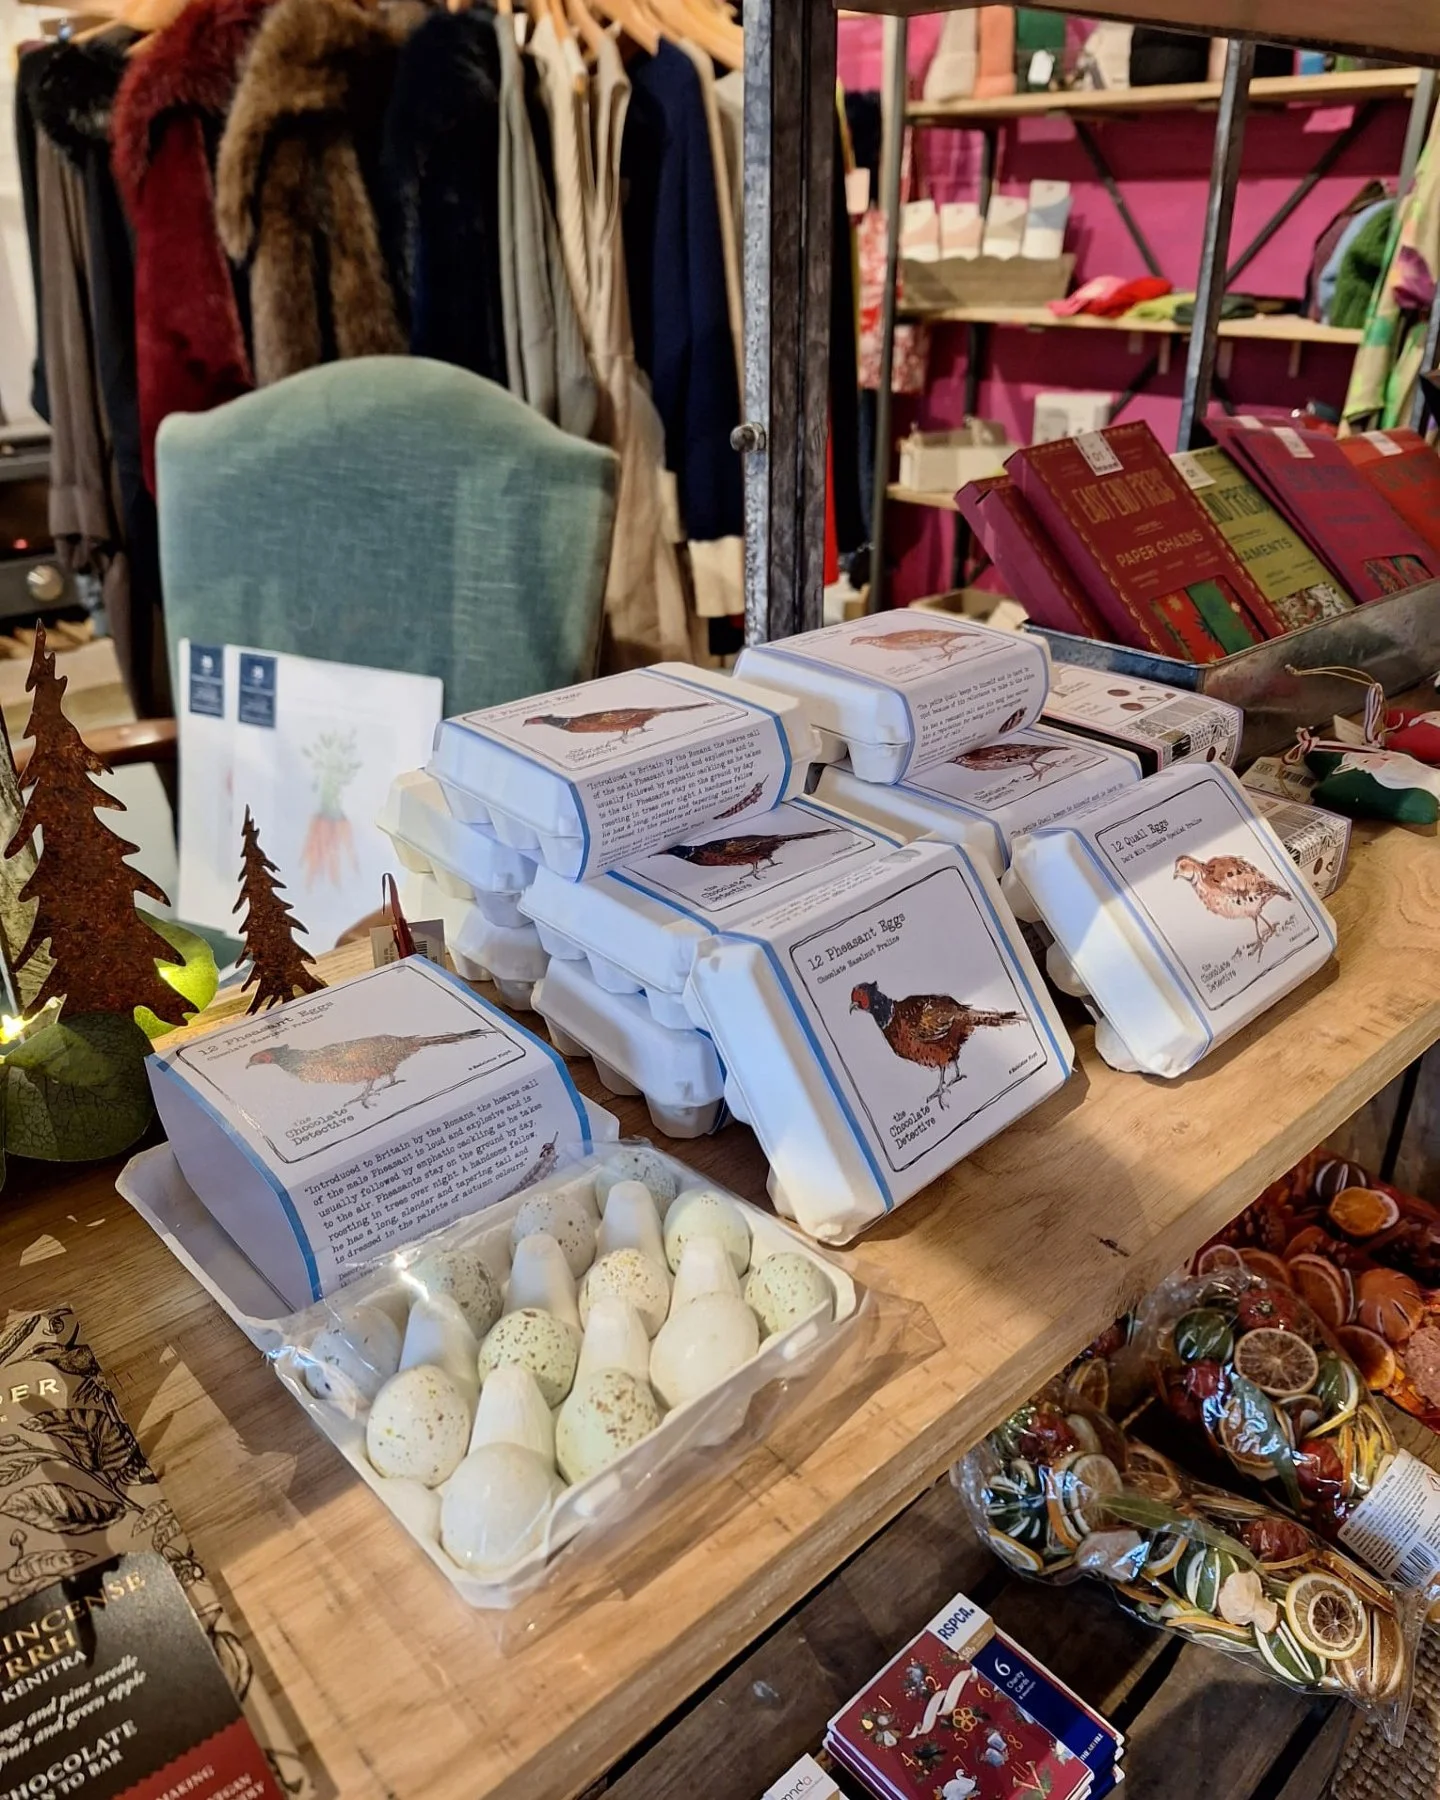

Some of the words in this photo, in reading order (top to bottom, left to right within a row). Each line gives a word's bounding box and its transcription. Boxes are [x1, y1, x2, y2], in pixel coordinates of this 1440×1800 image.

[1116, 545, 1158, 567] PAPER
[1156, 528, 1203, 553] CHAINS
[1111, 840, 1124, 852] 12
[1124, 828, 1148, 848] Quail
[1147, 819, 1169, 834] Eggs
[808, 955, 824, 971] 12
[825, 927, 877, 962] Pheasant
[878, 913, 906, 932] Eggs
[817, 965, 846, 984] Chocolate
[847, 948, 876, 968] Hazelnut
[876, 936, 900, 952] Praline
[198, 1045, 218, 1055] 12
[223, 1017, 294, 1046] Pheasant
[298, 1002, 334, 1017] Eggs
[285, 1106, 348, 1140] Chocolate
[292, 1114, 355, 1146] Detective
[363, 1160, 374, 1168] to
[376, 1142, 411, 1162] Britain
[412, 1135, 423, 1147] by
[426, 1127, 442, 1138] the
[477, 1103, 491, 1114] the
[492, 1090, 520, 1106] hoarse
[521, 1078, 539, 1092] call
[890, 1105, 930, 1138] Chocolate
[893, 1110, 906, 1122] the
[894, 1117, 936, 1150] Detective
[313, 1195, 324, 1206] of
[326, 1188, 344, 1200] the
[346, 1175, 368, 1190] male
[371, 1153, 414, 1178] Pheasant
[414, 1148, 424, 1157] is
[426, 1138, 446, 1152] loud
[448, 1129, 464, 1140] and
[466, 1109, 504, 1132] explosive
[506, 1100, 522, 1111] and
[522, 1095, 532, 1104] is
[318, 1194, 358, 1218] usually
[360, 1173, 400, 1198] followed
[403, 1166, 414, 1176] by
[416, 1145, 455, 1170] emphatic
[456, 1126, 496, 1149] cackling
[497, 1121, 506, 1130] as
[507, 1114, 518, 1124] he
[520, 1102, 542, 1117] takes
[323, 1220, 334, 1230] to
[336, 1210, 353, 1223] the
[376, 1175, 423, 1204] Pheasants
[424, 1165, 444, 1180] stay
[446, 1159, 458, 1168] on
[458, 1150, 474, 1161] the
[476, 1134, 504, 1155] ground
[506, 1127, 517, 1137] by
[328, 1217, 370, 1242] roosting
[371, 1210, 382, 1220] in
[384, 1197, 408, 1212] trees
[410, 1186, 430, 1200] over
[462, 1166, 468, 1174] A
[470, 1146, 508, 1170] handsome
[331, 1243, 344, 1254] he
[347, 1233, 364, 1245] has
[402, 1196, 435, 1218] slender
[438, 1186, 454, 1199] and
[456, 1166, 493, 1188] tapering
[495, 1155, 512, 1168] tail
[514, 1146, 529, 1158] and
[335, 1256, 344, 1264] is
[348, 1236, 381, 1258] dressed
[385, 1230, 395, 1239] in
[398, 1219, 413, 1232] the
[416, 1201, 448, 1224] palette
[451, 1194, 460, 1203] of
[462, 1178, 494, 1198] autumn
[2, 1650, 87, 1704] KENITRA
[994, 1656, 1010, 1676] 6
[1006, 1670, 1025, 1688] Charity
[27, 1696, 56, 1727] and
[60, 1682, 92, 1713] pine
[94, 1654, 138, 1688] needle
[925, 1676, 941, 1690] 2
[976, 1682, 992, 1698] 6
[1014, 1678, 1030, 1692] Cards
[34, 1713, 64, 1746] and
[66, 1695, 106, 1730] green
[108, 1670, 146, 1702] apple
[878, 1694, 892, 1708] 1
[953, 1732, 968, 1749] 5
[1006, 1734, 1023, 1749] 8
[56, 1772, 85, 1794] TO
[88, 1750, 124, 1778] BAR
[901, 1752, 916, 1767] 4
[952, 1755, 968, 1770] 7
[1010, 1761, 1030, 1780] 11
